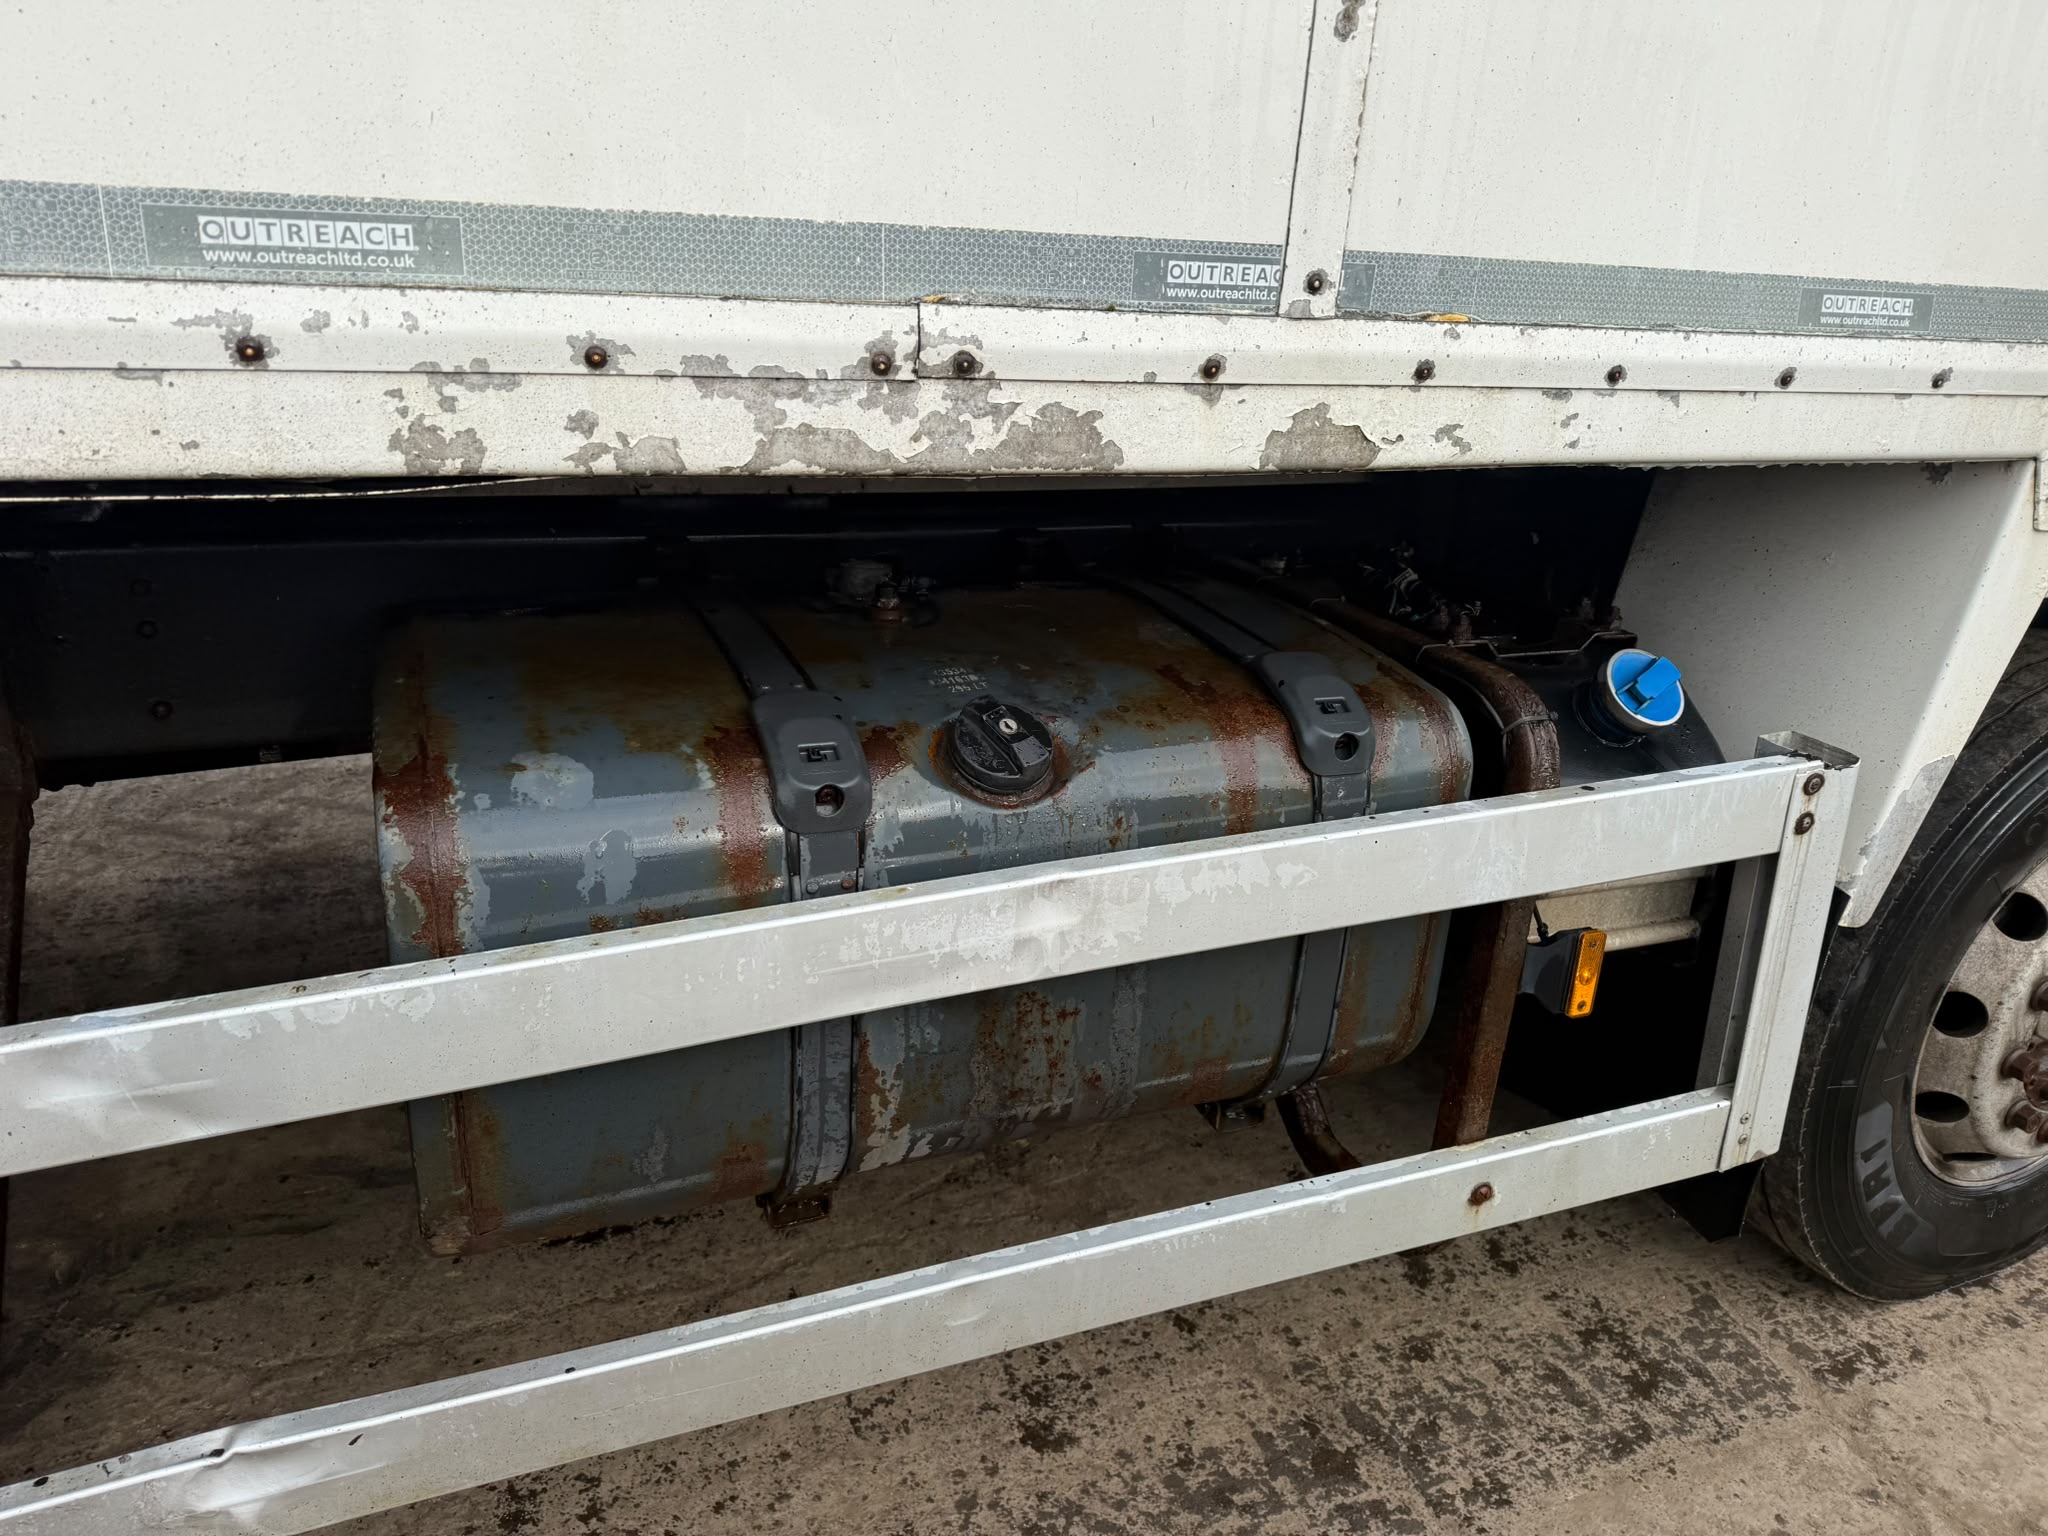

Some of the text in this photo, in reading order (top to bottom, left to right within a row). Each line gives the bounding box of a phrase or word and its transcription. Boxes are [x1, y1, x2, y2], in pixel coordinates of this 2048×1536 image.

[200, 219, 412, 247] OUTREACH
[202, 250, 416, 268] www.outreachltd.co.uk
[1823, 296, 1913, 314] OUTREACH
[1819, 315, 1911, 327] www.outreachltd.co.uk
